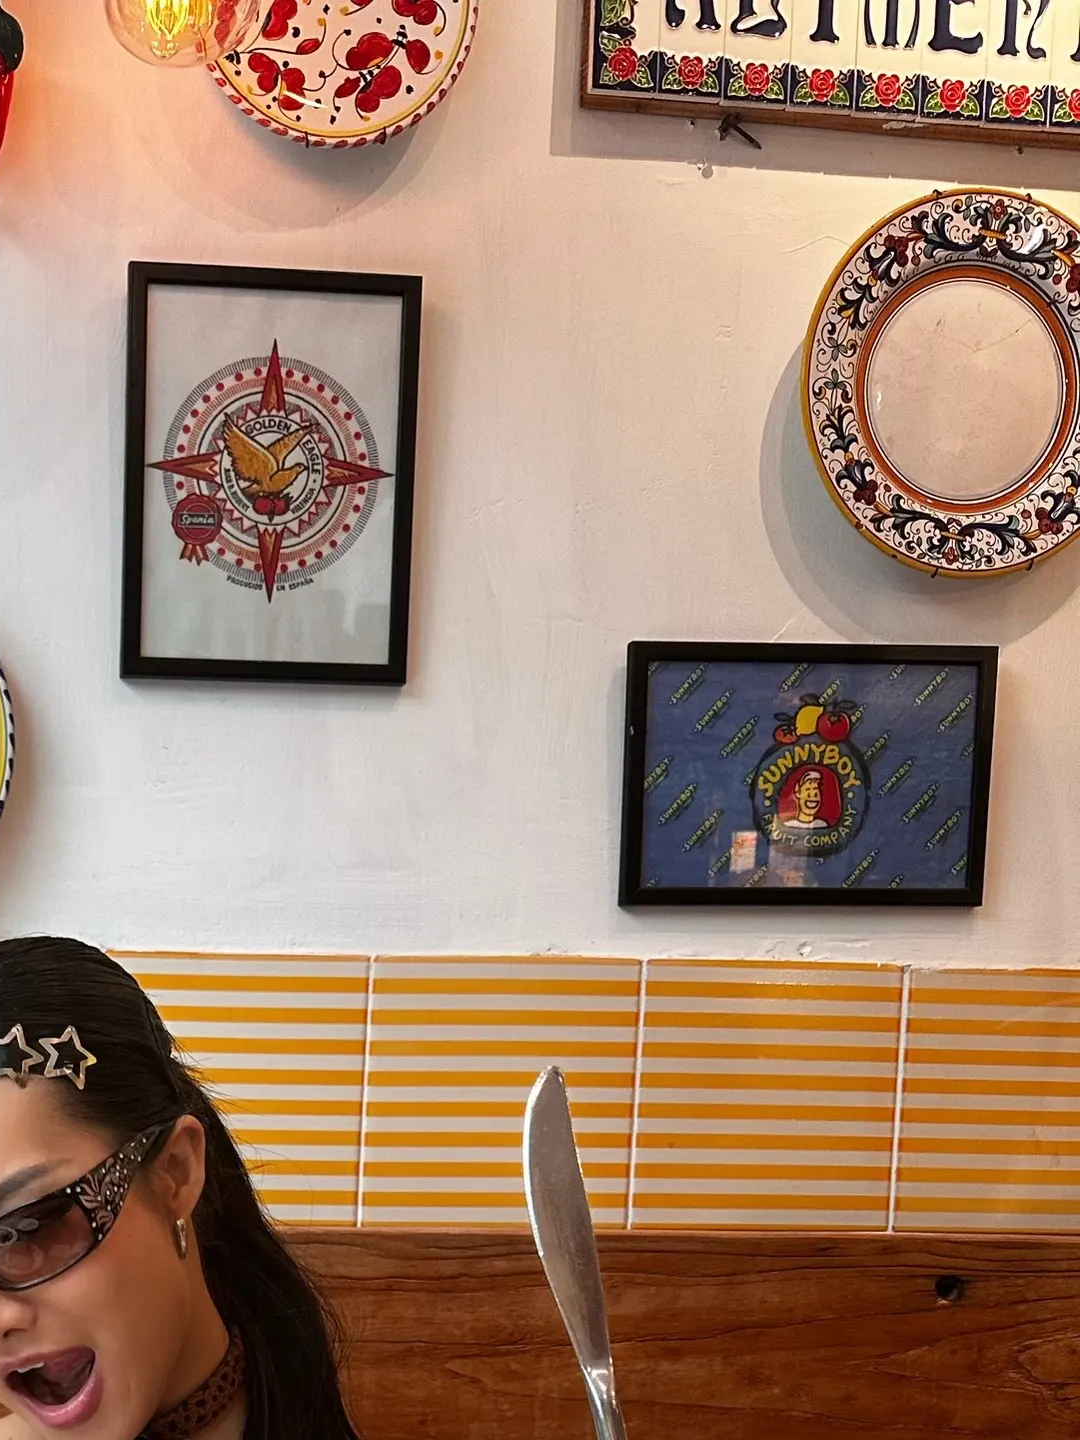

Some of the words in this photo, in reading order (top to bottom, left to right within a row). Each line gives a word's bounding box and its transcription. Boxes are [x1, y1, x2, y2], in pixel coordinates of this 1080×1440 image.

[245, 418, 292, 434] GOLDEN
[302, 438, 321, 476] EAGLE
[180, 513, 216, 526] Spania
[290, 487, 316, 515] VALENCIA
[671, 663, 705, 704] SUNNYBOY
[819, 678, 841, 704] NYBOY
[696, 691, 731, 731] SUNNYBOY
[939, 693, 974, 732] SUNNYBOY
[721, 718, 756, 758] SUNNYBOY
[758, 743, 861, 797] SUNNYBOY
[763, 814, 798, 845] FRUIT
[804, 804, 857, 847] COMPANY
